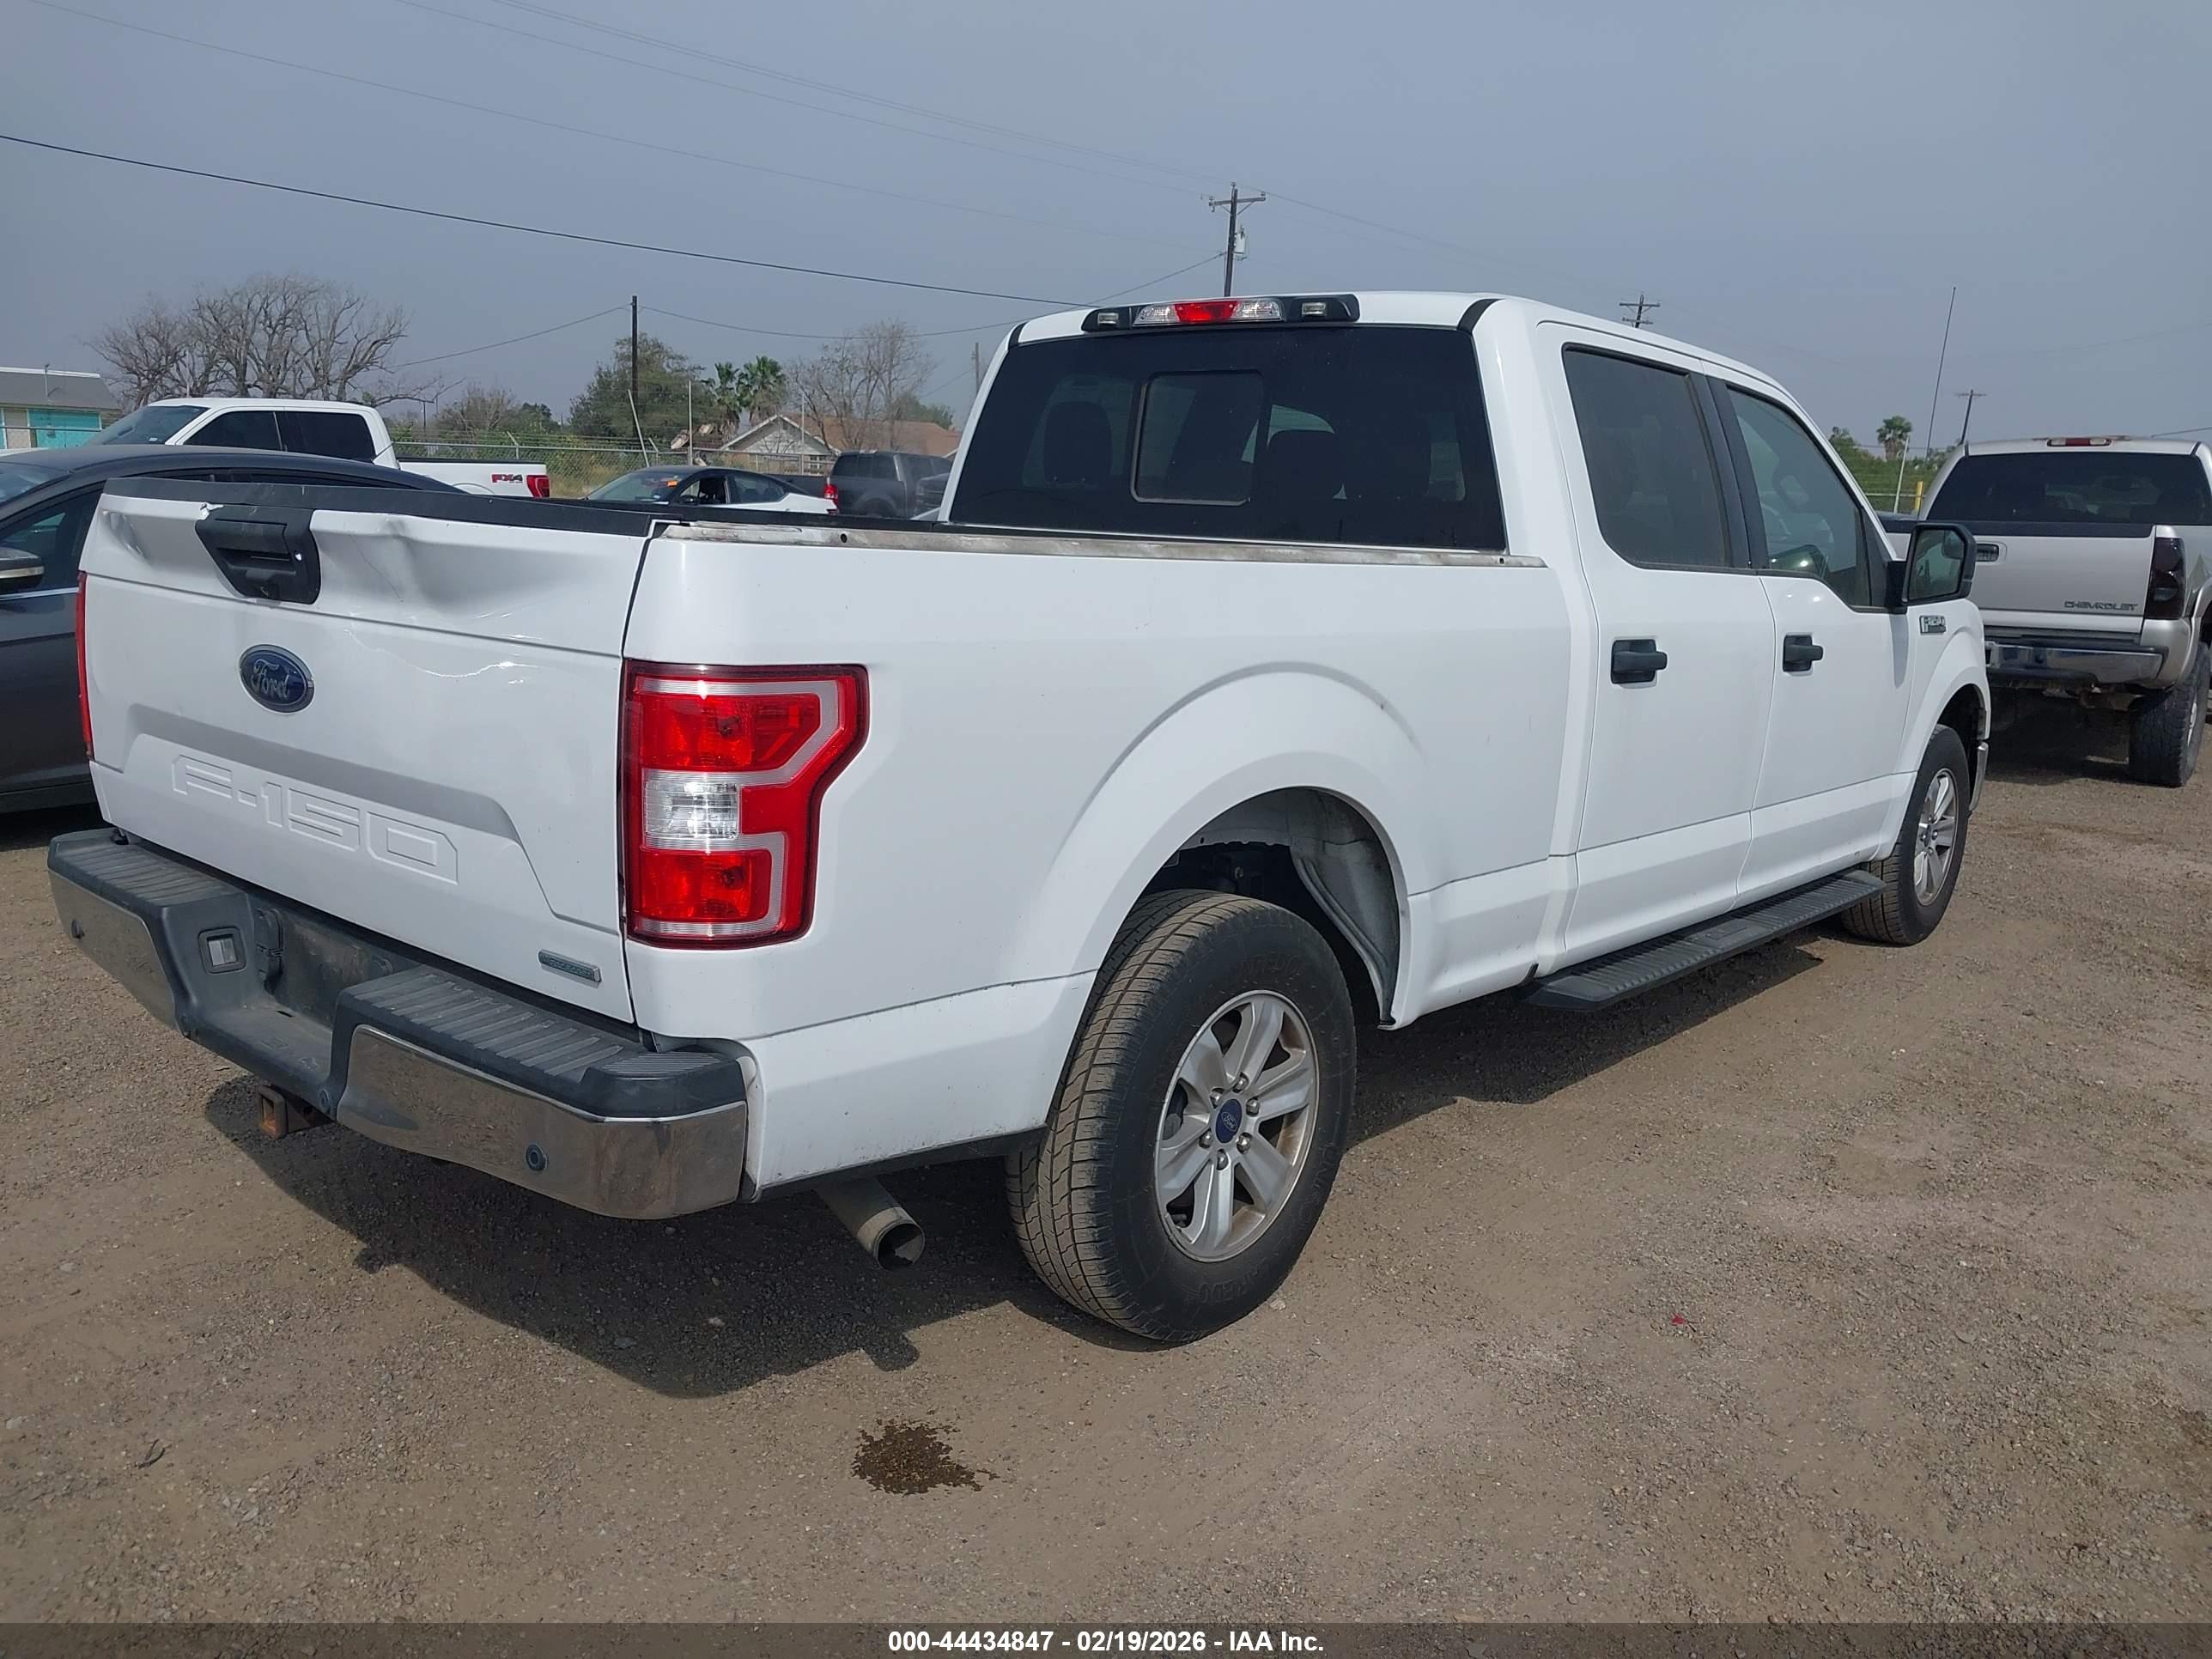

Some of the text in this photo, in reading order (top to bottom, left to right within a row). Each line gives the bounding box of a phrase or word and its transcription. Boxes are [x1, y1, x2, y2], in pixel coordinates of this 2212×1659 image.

[491, 474, 523, 483] FX4
[2064, 601, 2138, 611] CHEVROLET
[250, 659, 290, 699] Ford
[172, 754, 459, 885] F-150
